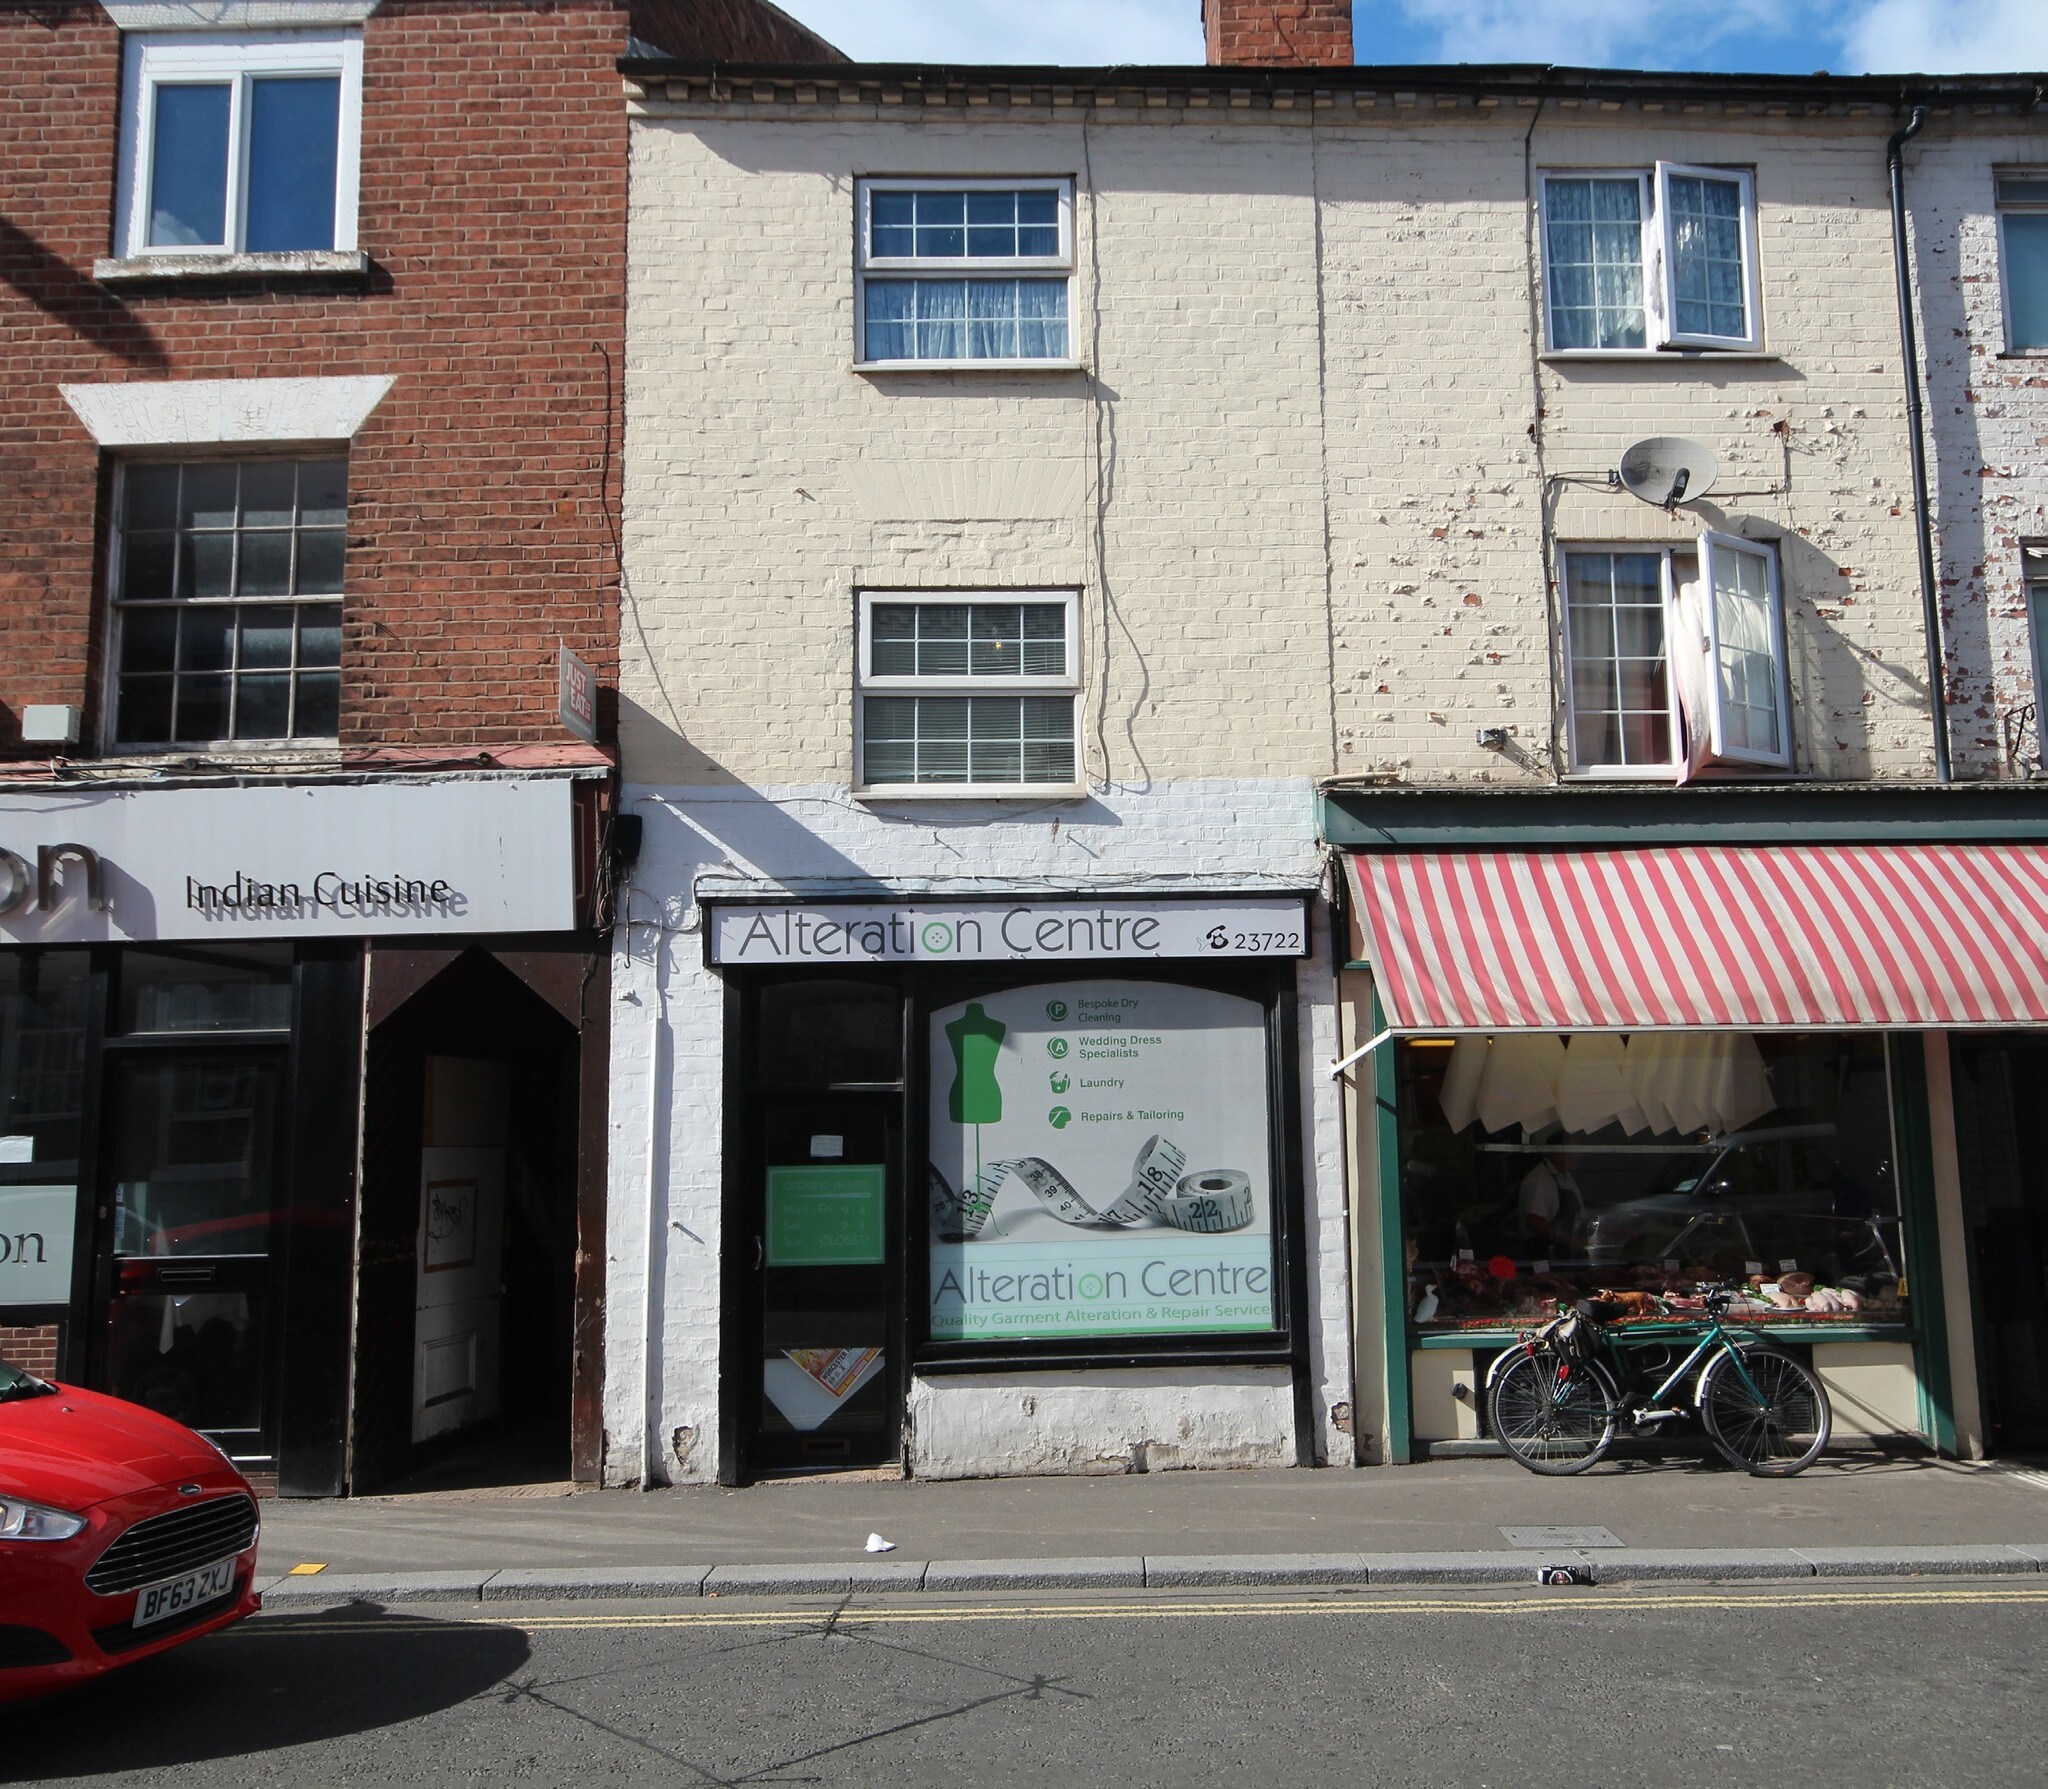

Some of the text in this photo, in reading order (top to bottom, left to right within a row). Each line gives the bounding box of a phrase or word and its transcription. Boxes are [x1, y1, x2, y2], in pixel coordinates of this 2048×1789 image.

[565, 662, 586, 694] JUST
[570, 686, 587, 716] EAT
[186, 871, 449, 909] Indian Cuisine
[738, 907, 1300, 957] Alteration Centre 23722
[1078, 998, 1139, 1010] Bespoke Dry
[1078, 1012, 1121, 1024] Cleaning
[1079, 1035, 1162, 1047] Wedding Dress
[1079, 1049, 1139, 1060] Specialists
[1080, 1077, 1125, 1088] Laundry
[1081, 1110, 1184, 1123] Repairs & Tailoring
[1138, 1167, 1163, 1195] 18
[1045, 1185, 1057, 1198] 39
[1060, 1201, 1072, 1212] 40
[1189, 1200, 1220, 1219] 22
[819, 1234, 870, 1247] CLOSED
[932, 1260, 1268, 1304] Alteration Centre
[931, 1304, 1270, 1328] Quality Garment Alteration & Repair Service
[822, 1351, 849, 1380] WORCESTER
[143, 1563, 231, 1619] BF63 ZXJ
